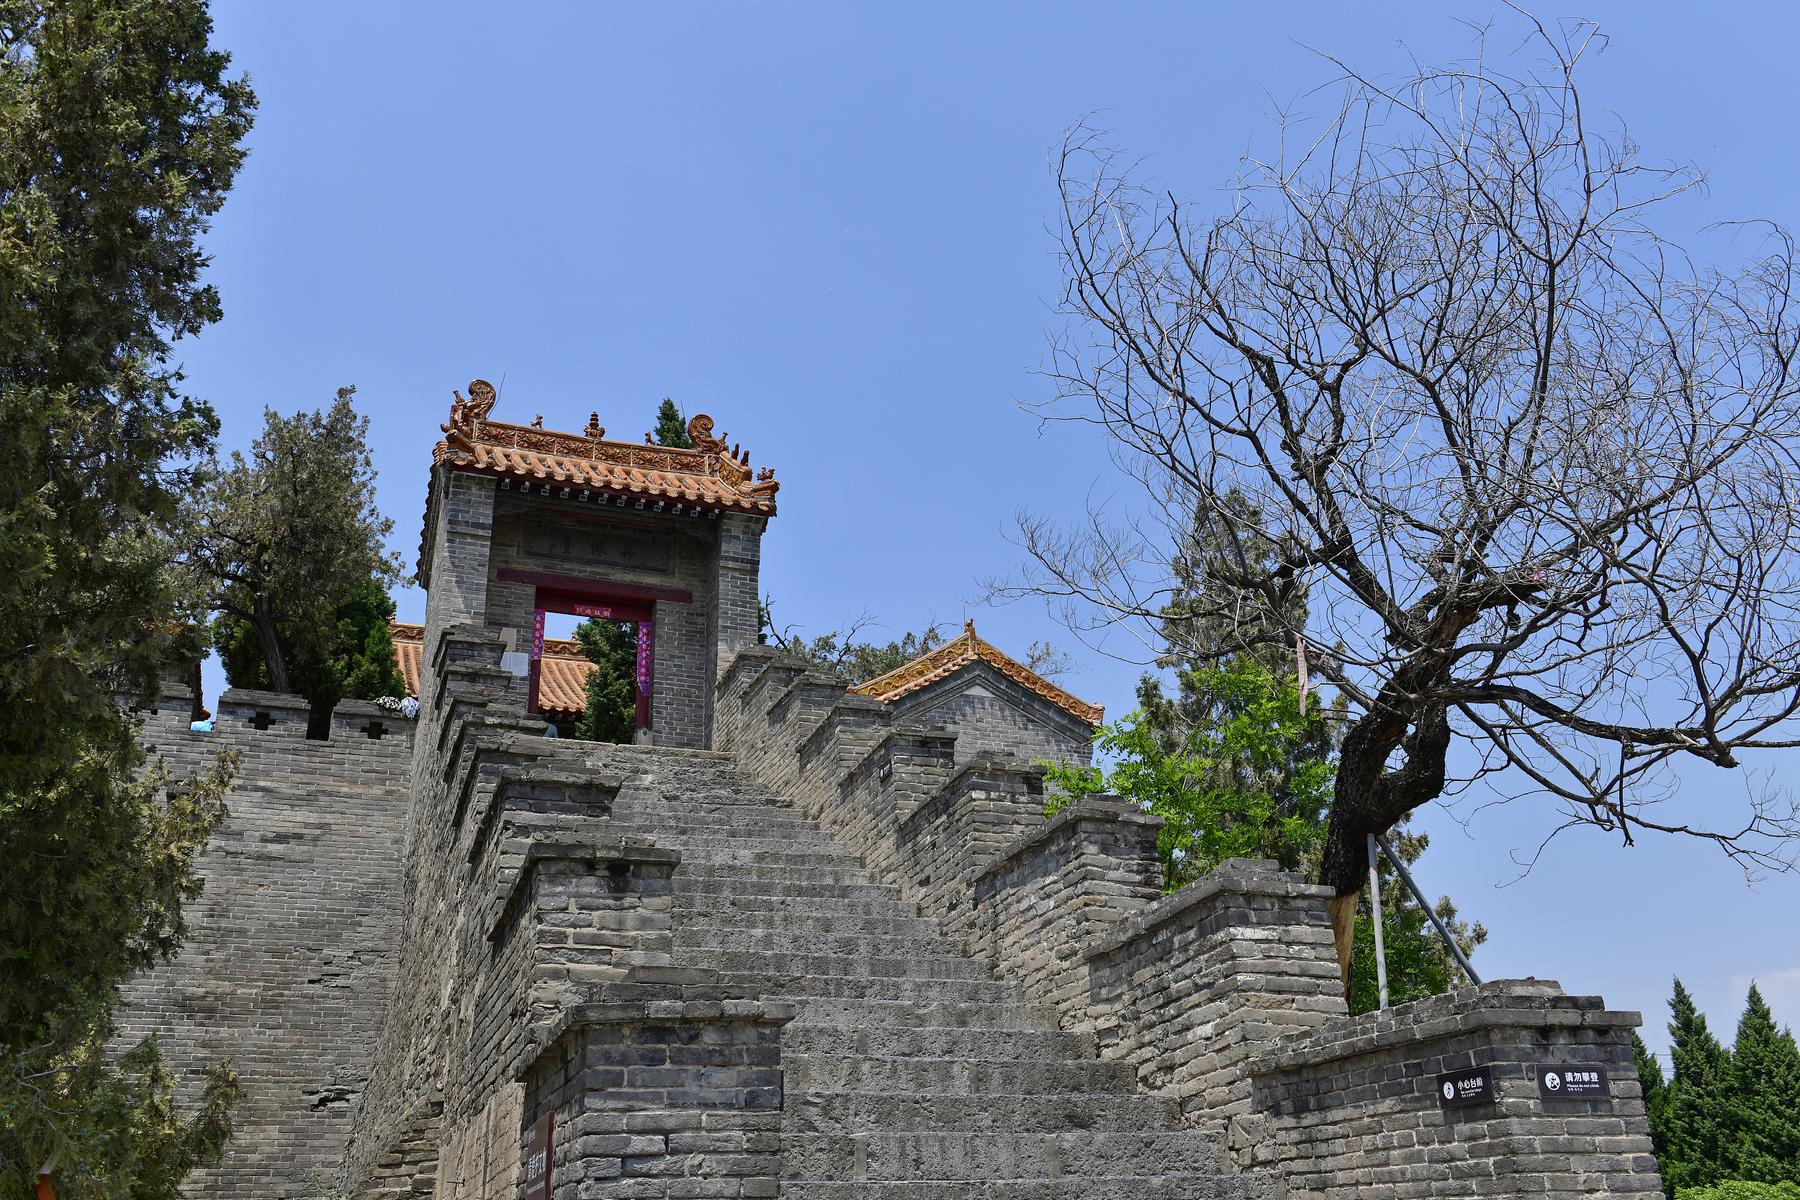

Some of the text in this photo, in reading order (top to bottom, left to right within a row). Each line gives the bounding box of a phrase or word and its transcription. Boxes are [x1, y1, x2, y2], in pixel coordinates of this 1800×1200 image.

[1564, 1071, 1599, 1082] 请勿攀登
[1457, 1076, 1483, 1090] 小心台阶
